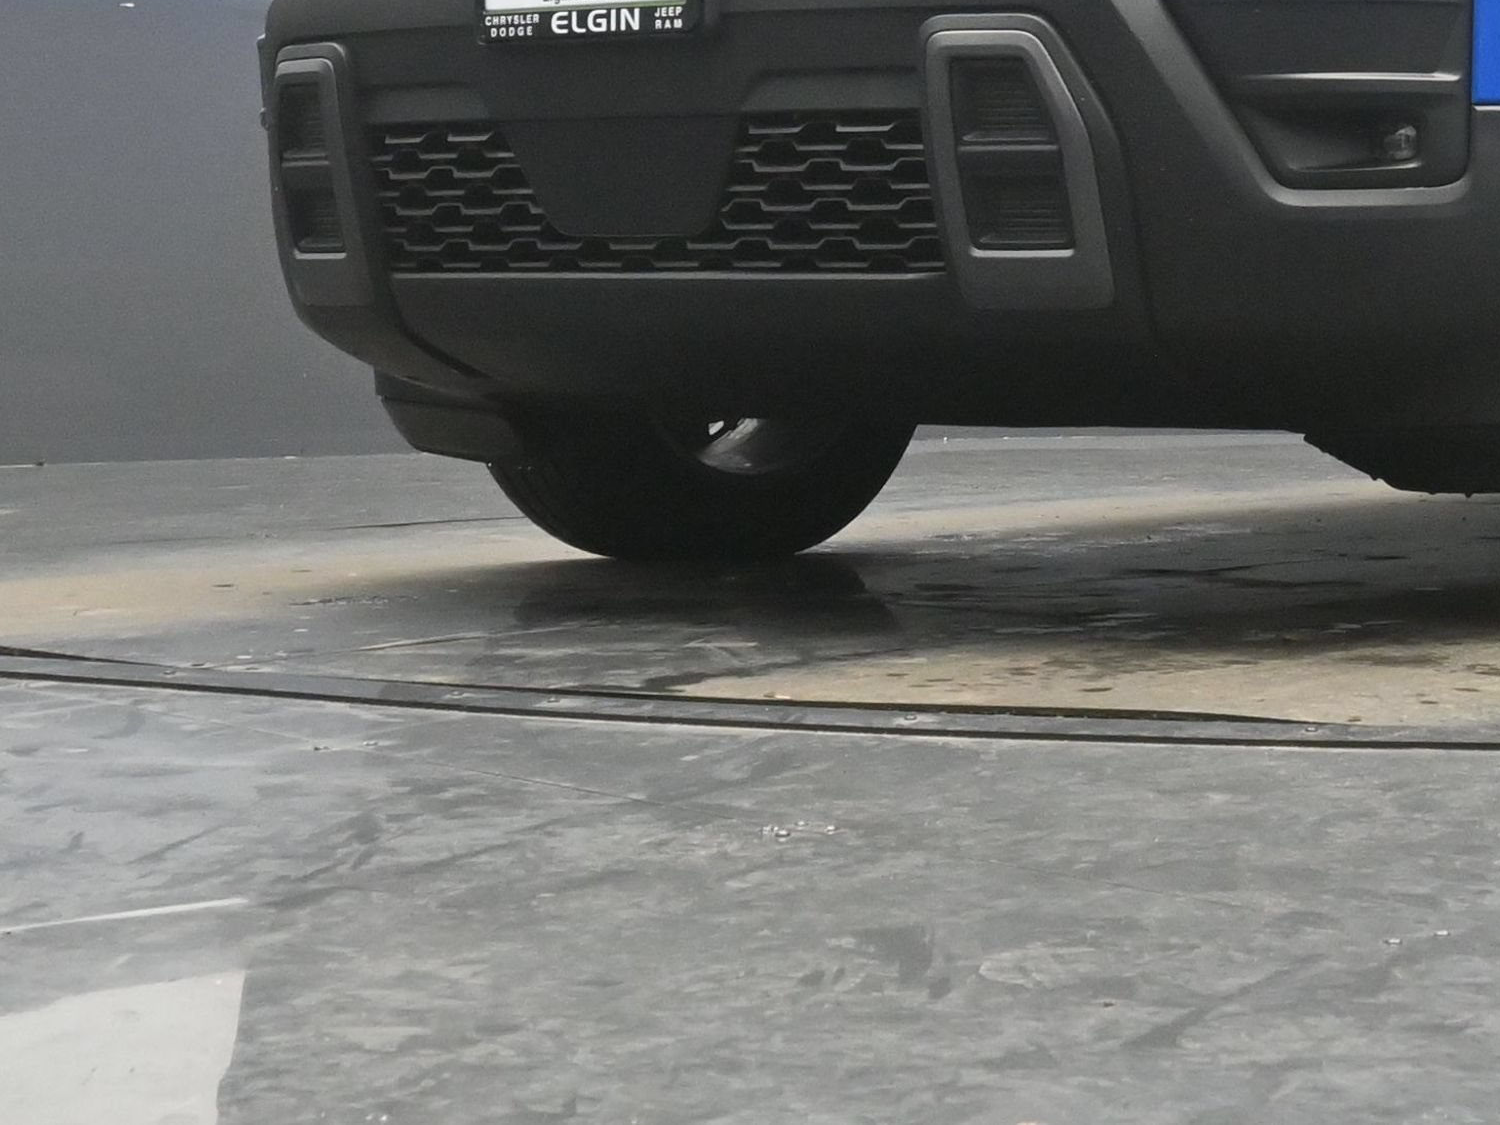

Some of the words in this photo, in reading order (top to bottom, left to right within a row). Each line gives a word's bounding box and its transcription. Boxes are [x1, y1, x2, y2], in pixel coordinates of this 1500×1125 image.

[654, 6, 683, 18] JEEP
[485, 14, 540, 26] CHRYSLER
[550, 8, 641, 35] ELGIN
[655, 19, 683, 30] RAM
[490, 27, 533, 38] DODGE
